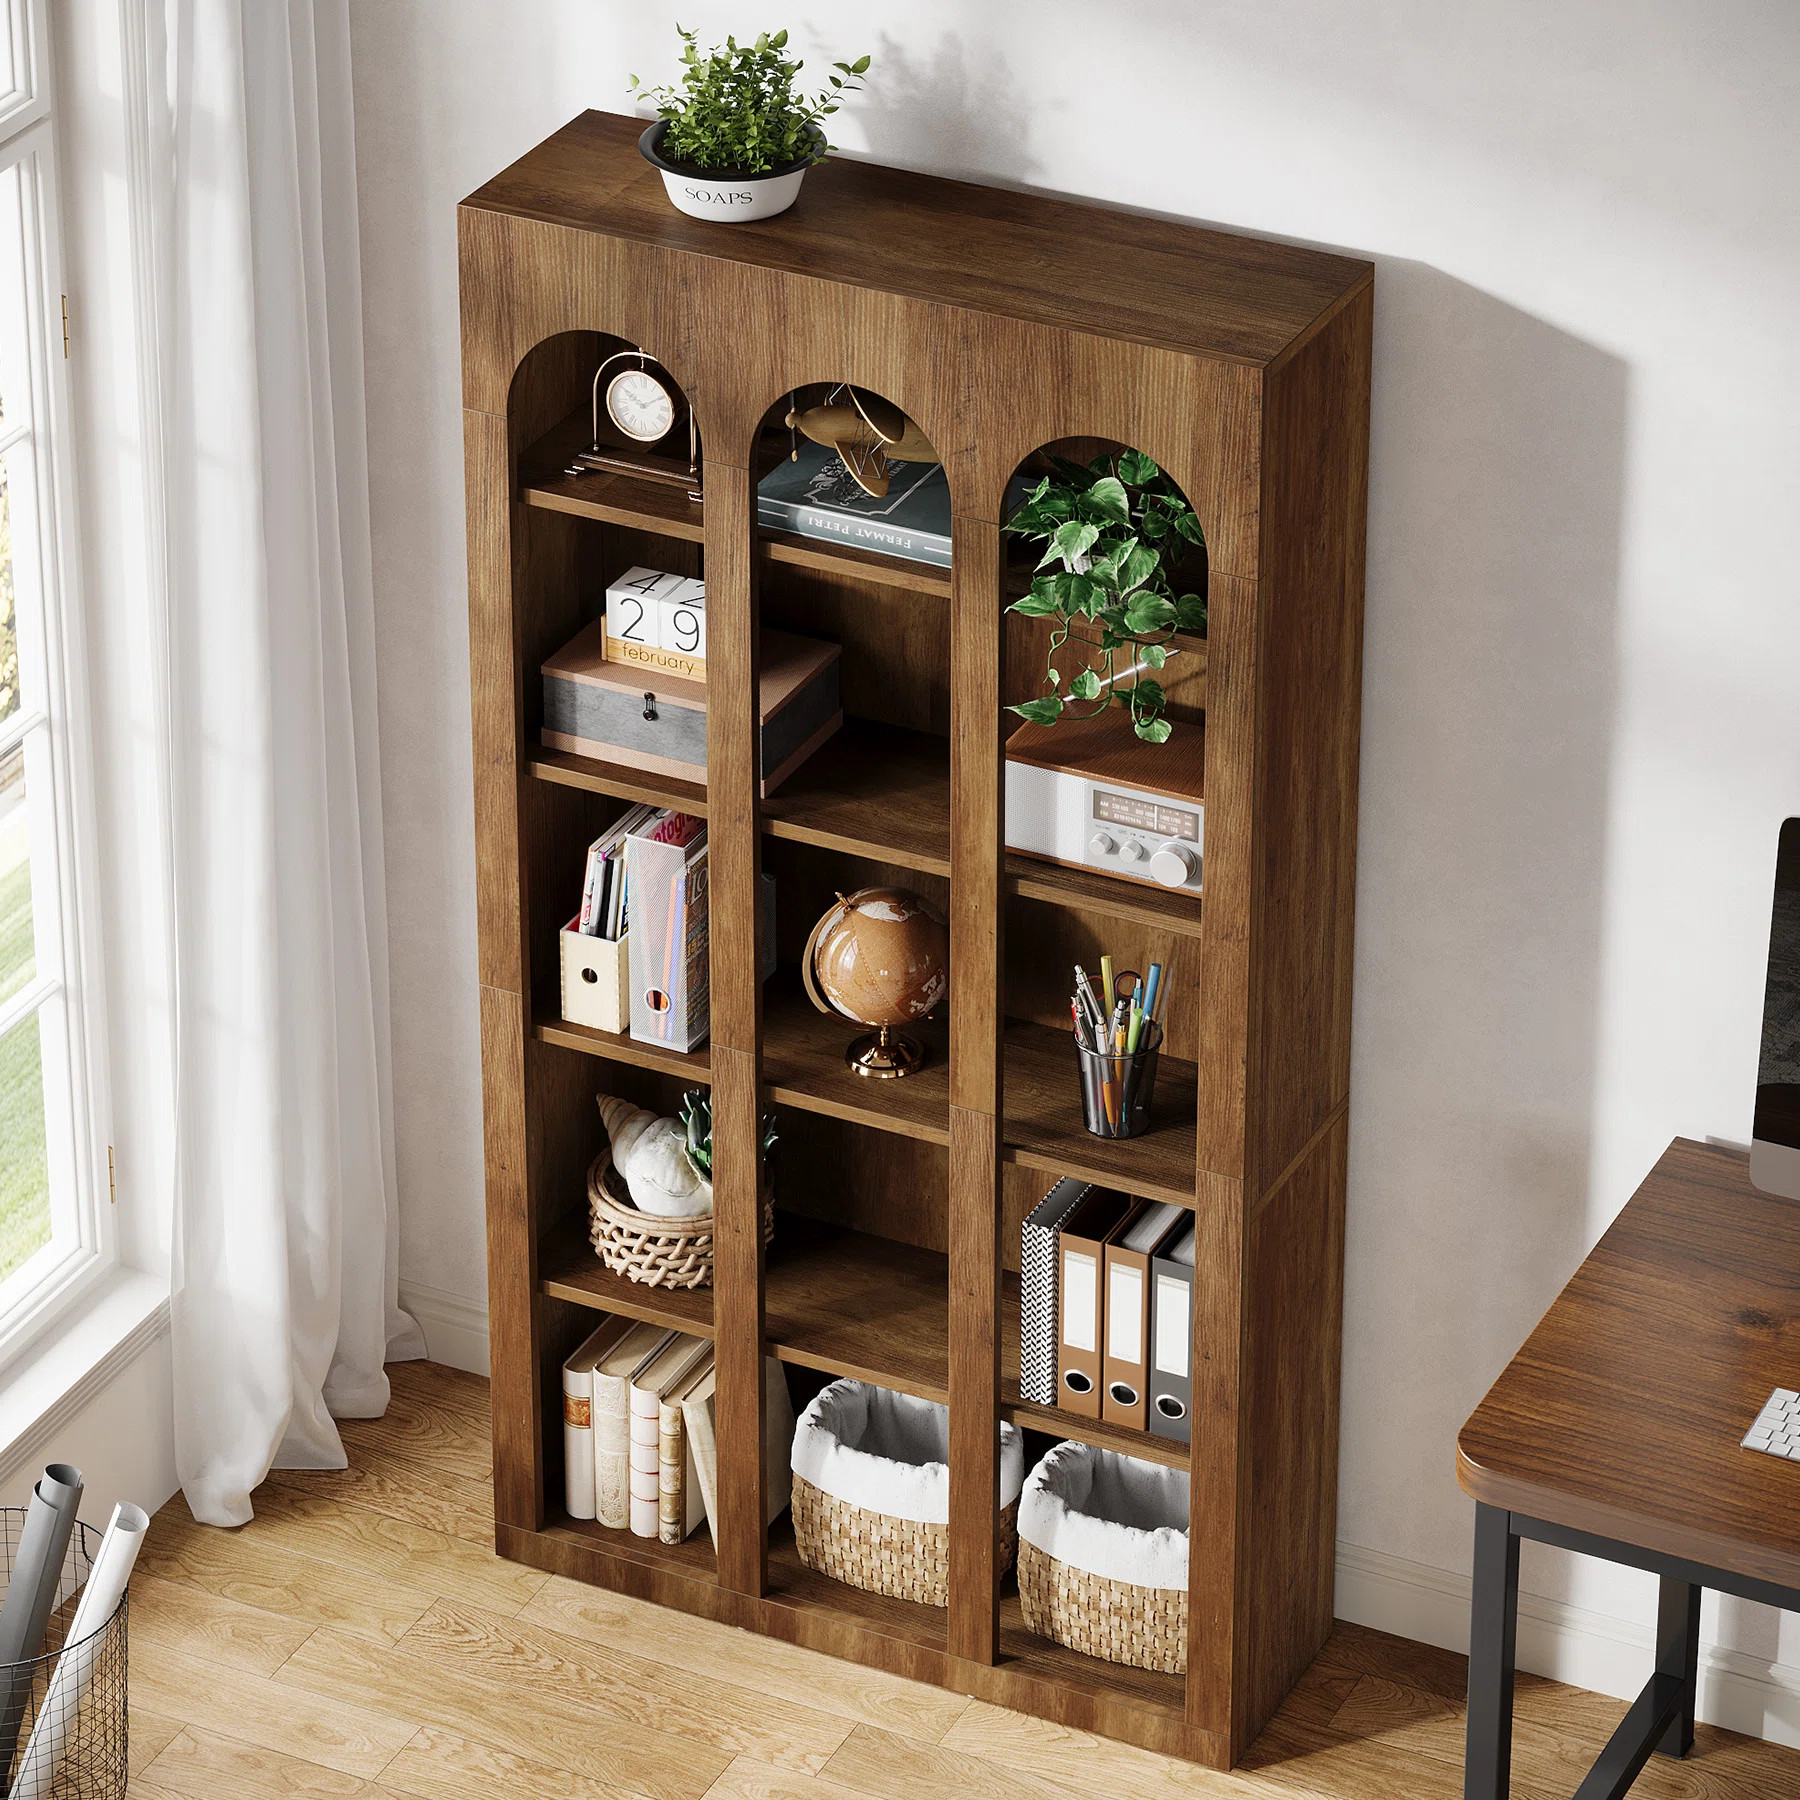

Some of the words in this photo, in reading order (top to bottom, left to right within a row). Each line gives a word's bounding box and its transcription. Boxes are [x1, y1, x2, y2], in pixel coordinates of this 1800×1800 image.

[685, 187, 753, 204] SOAPS
[808, 516, 850, 536] PETRI
[855, 528, 912, 549] FERMAT
[625, 573, 666, 594] 4
[622, 643, 695, 676] february
